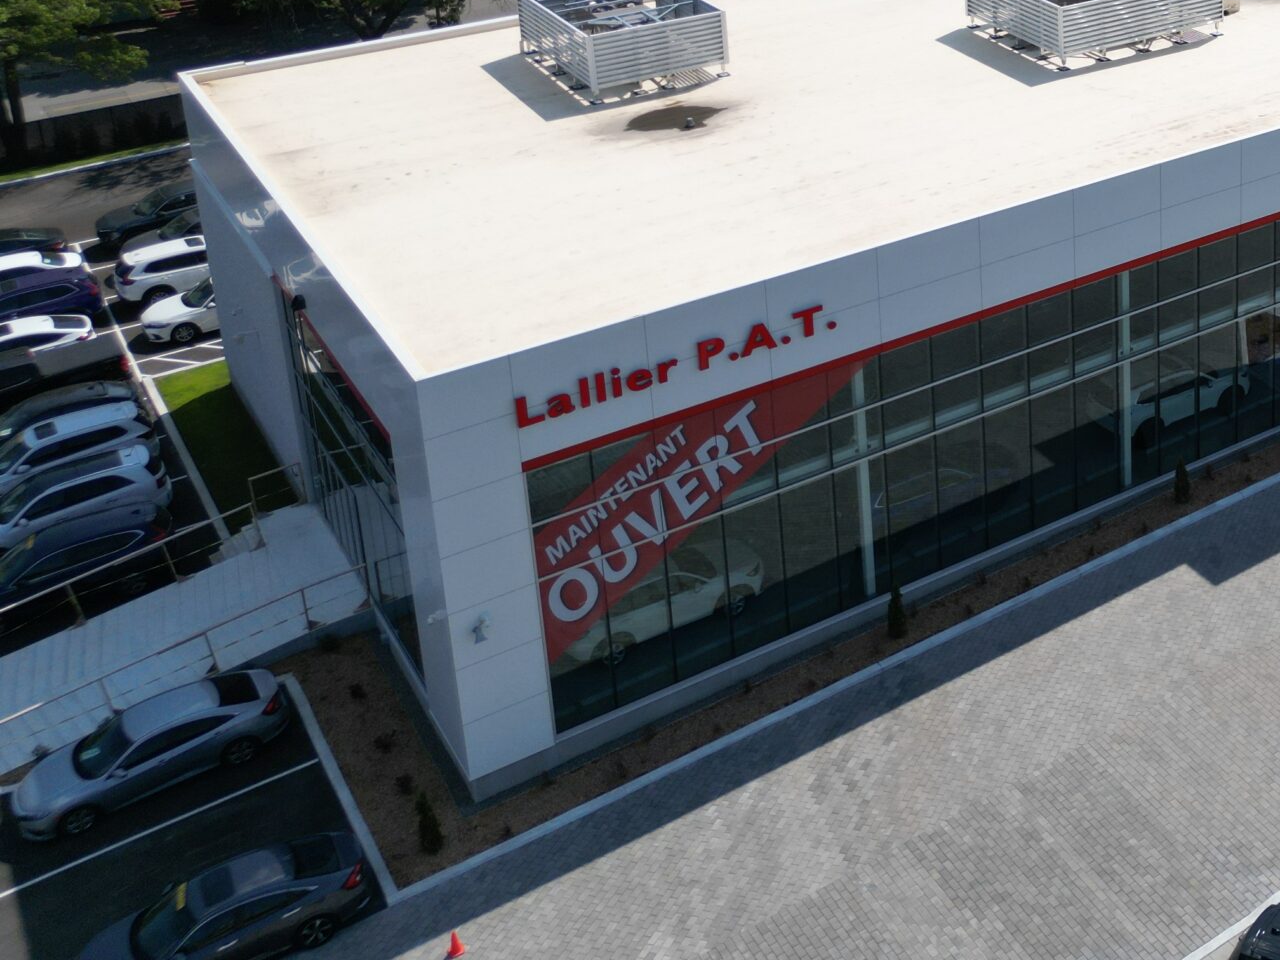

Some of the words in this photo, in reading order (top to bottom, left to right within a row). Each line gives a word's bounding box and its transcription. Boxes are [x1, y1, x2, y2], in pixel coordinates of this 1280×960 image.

[513, 357, 679, 429] Lallier
[696, 305, 837, 371] P.A.T.
[544, 424, 688, 566] MAINTENANT
[547, 399, 766, 623] OUVERT
